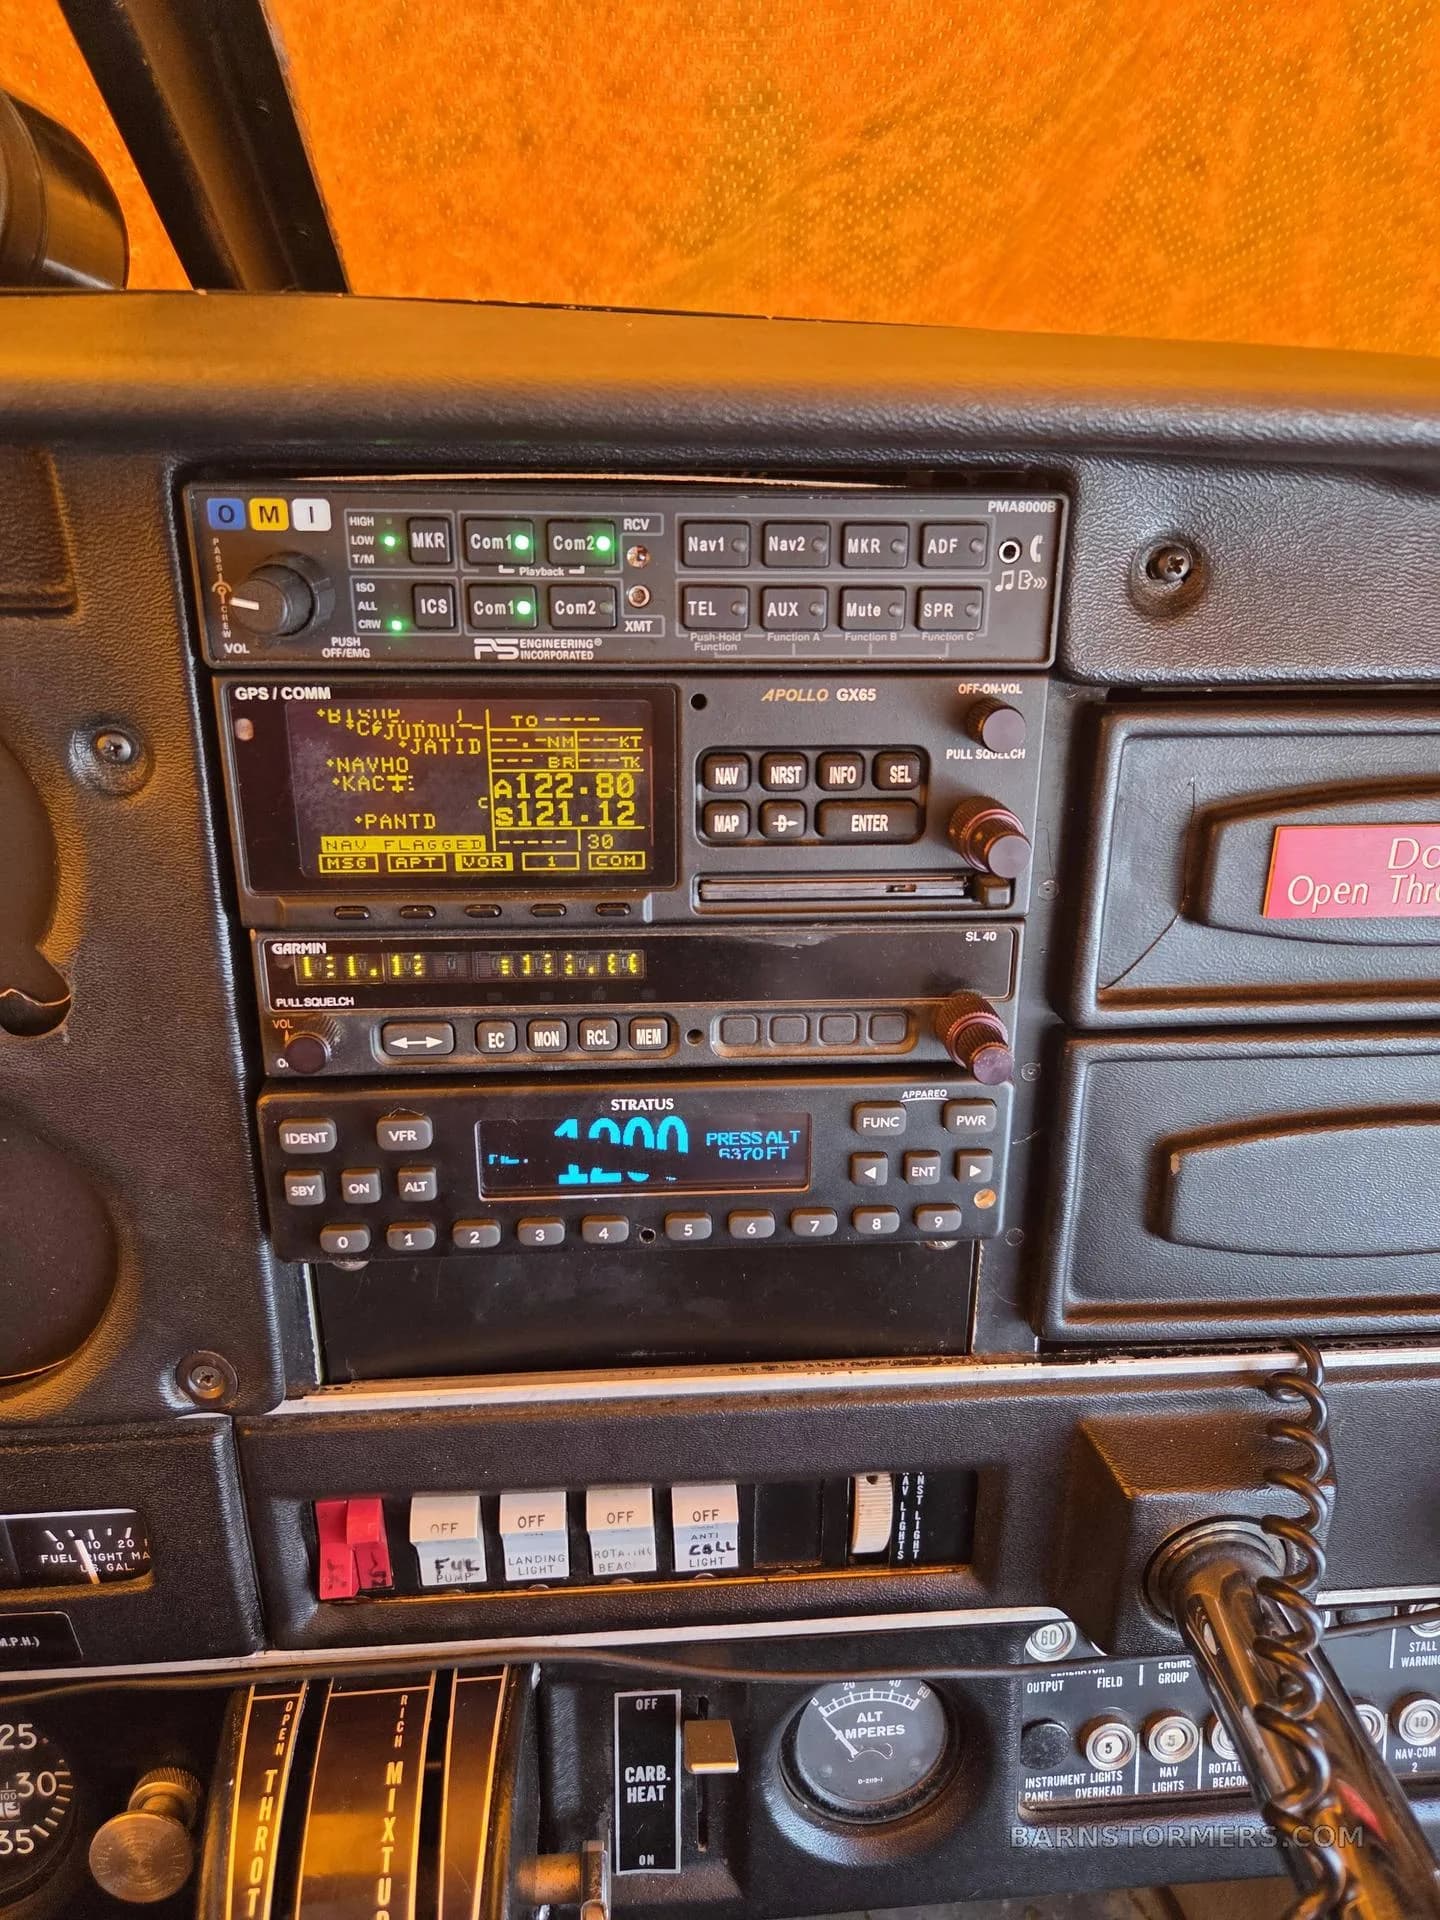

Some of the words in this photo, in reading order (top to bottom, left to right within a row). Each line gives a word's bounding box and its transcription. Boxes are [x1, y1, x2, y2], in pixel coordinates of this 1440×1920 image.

[988, 501, 1056, 513] PMA8000B
[218, 505, 234, 523] O
[259, 506, 279, 523] M
[350, 517, 374, 526] HIGH
[624, 519, 649, 530] RCV
[351, 536, 374, 545] LOW
[412, 532, 445, 548] MKR
[471, 534, 512, 549] Com1
[553, 535, 594, 551] Com2
[688, 537, 724, 551] Nav1
[769, 536, 805, 551] Nav2
[848, 538, 880, 554] MKR
[928, 539, 958, 554] ADF
[352, 555, 374, 564] T/M
[519, 567, 564, 576] Playback
[356, 583, 375, 592] ISO
[358, 601, 377, 611] ALL
[420, 598, 448, 614] ICS
[474, 600, 514, 615] Com1
[555, 600, 596, 615] Com2
[688, 601, 717, 615] TEL
[768, 602, 798, 617] AUX
[847, 603, 881, 617] Mute
[924, 603, 953, 617] SPR
[358, 620, 381, 628] CRW
[624, 621, 653, 632] XMT
[331, 637, 360, 646] PUSH
[690, 633, 741, 641] Push-Hold
[767, 633, 810, 641] Function
[812, 633, 820, 641] A
[845, 633, 887, 641] Function
[922, 633, 964, 641] Function
[966, 633, 975, 641] C
[224, 644, 249, 653] VOL
[322, 648, 370, 658] OFF/EMG
[694, 643, 737, 651] Function
[520, 650, 594, 660] INCORPORATED
[235, 687, 269, 699] GPS
[282, 687, 331, 699] COMM
[762, 689, 828, 701] APOLLO
[836, 688, 876, 701] GX65
[958, 684, 1022, 694] OFF-ON-VOL
[511, 715, 538, 727] TO
[411, 739, 481, 754] JATID
[946, 749, 973, 759] PULL
[715, 767, 738, 785] NAV
[771, 767, 801, 784] NRST
[829, 766, 856, 784] INFO
[890, 766, 911, 783] SEL
[365, 813, 436, 829] PANTD
[714, 815, 739, 832] MAP
[851, 814, 888, 832] ENTER
[326, 840, 367, 851] NAV
[384, 840, 481, 850] FLAGGED
[327, 858, 366, 869] MSG
[396, 858, 436, 868] APT
[463, 856, 504, 867] VOR
[597, 855, 635, 866] COM
[1288, 875, 1369, 913] Open
[966, 932, 980, 941] SL
[983, 931, 997, 941] 40
[272, 943, 326, 954] GARMIN
[277, 999, 302, 1007] PULL
[304, 997, 354, 1007] SQUELCH
[272, 1020, 293, 1029] VOL
[488, 1033, 505, 1048] EC
[534, 1032, 559, 1046] MON
[587, 1030, 609, 1045] RCL
[637, 1029, 661, 1044] MEM
[903, 1090, 947, 1098] APPAREO
[611, 1099, 674, 1111] STRATUS
[863, 1117, 900, 1128] FUNC
[956, 1115, 986, 1126] PWR
[285, 1132, 328, 1144] IDENT
[388, 1131, 417, 1142] VFR
[706, 1131, 762, 1146] PRESS
[766, 1130, 801, 1144] ALT
[767, 1146, 790, 1160] FT
[912, 1167, 936, 1177] ENT
[291, 1185, 315, 1196] SBY
[349, 1183, 369, 1194] ON
[405, 1182, 427, 1192] ALT
[337, 1237, 348, 1248] 0
[405, 1234, 414, 1245] 1
[470, 1232, 480, 1244] 2
[536, 1230, 545, 1241] 3
[599, 1228, 609, 1239] 4
[684, 1224, 692, 1236] 5
[747, 1223, 756, 1234] 6
[810, 1221, 819, 1232] 7
[872, 1218, 881, 1230] 8
[934, 1216, 943, 1228] 9
[518, 1515, 545, 1528] OFF
[607, 1511, 634, 1524] OFF
[692, 1509, 719, 1522] OFF
[430, 1523, 458, 1533] OFF
[690, 1532, 719, 1540] ANTI
[88, 1541, 101, 1549] 10
[118, 1540, 134, 1548] 20
[41, 1555, 77, 1563] FUEL
[509, 1555, 566, 1566] LANDING
[689, 1556, 725, 1568] LIGHT
[107, 1563, 135, 1571] GAL.
[518, 1565, 554, 1576] LIGHT
[1041, 1630, 1057, 1645] 60
[1409, 1640, 1437, 1652] STALL
[1027, 1680, 1064, 1693] OUTPUT
[1097, 1677, 1122, 1688] FIELD
[1158, 1672, 1189, 1684] GROUP
[636, 1698, 658, 1711] OFF
[394, 1695, 408, 1748] RICH
[857, 1711, 883, 1723] ALT
[275, 1700, 293, 1756] OPEN
[835, 1725, 905, 1740] AMPERES
[0, 1723, 38, 1750] 25
[1395, 1747, 1436, 1759] NAV-COM
[624, 1765, 671, 1783] CARB.
[1160, 1767, 1178, 1777] NAV
[16, 1771, 57, 1797] 30
[1025, 1773, 1086, 1788] INSTRUMENT
[1090, 1771, 1123, 1784] LIGHTS
[1075, 1786, 1122, 1798] OVERHEAD
[1152, 1780, 1184, 1792] LIGHTS
[627, 1785, 666, 1803] HEAT
[639, 1855, 654, 1866] ON
